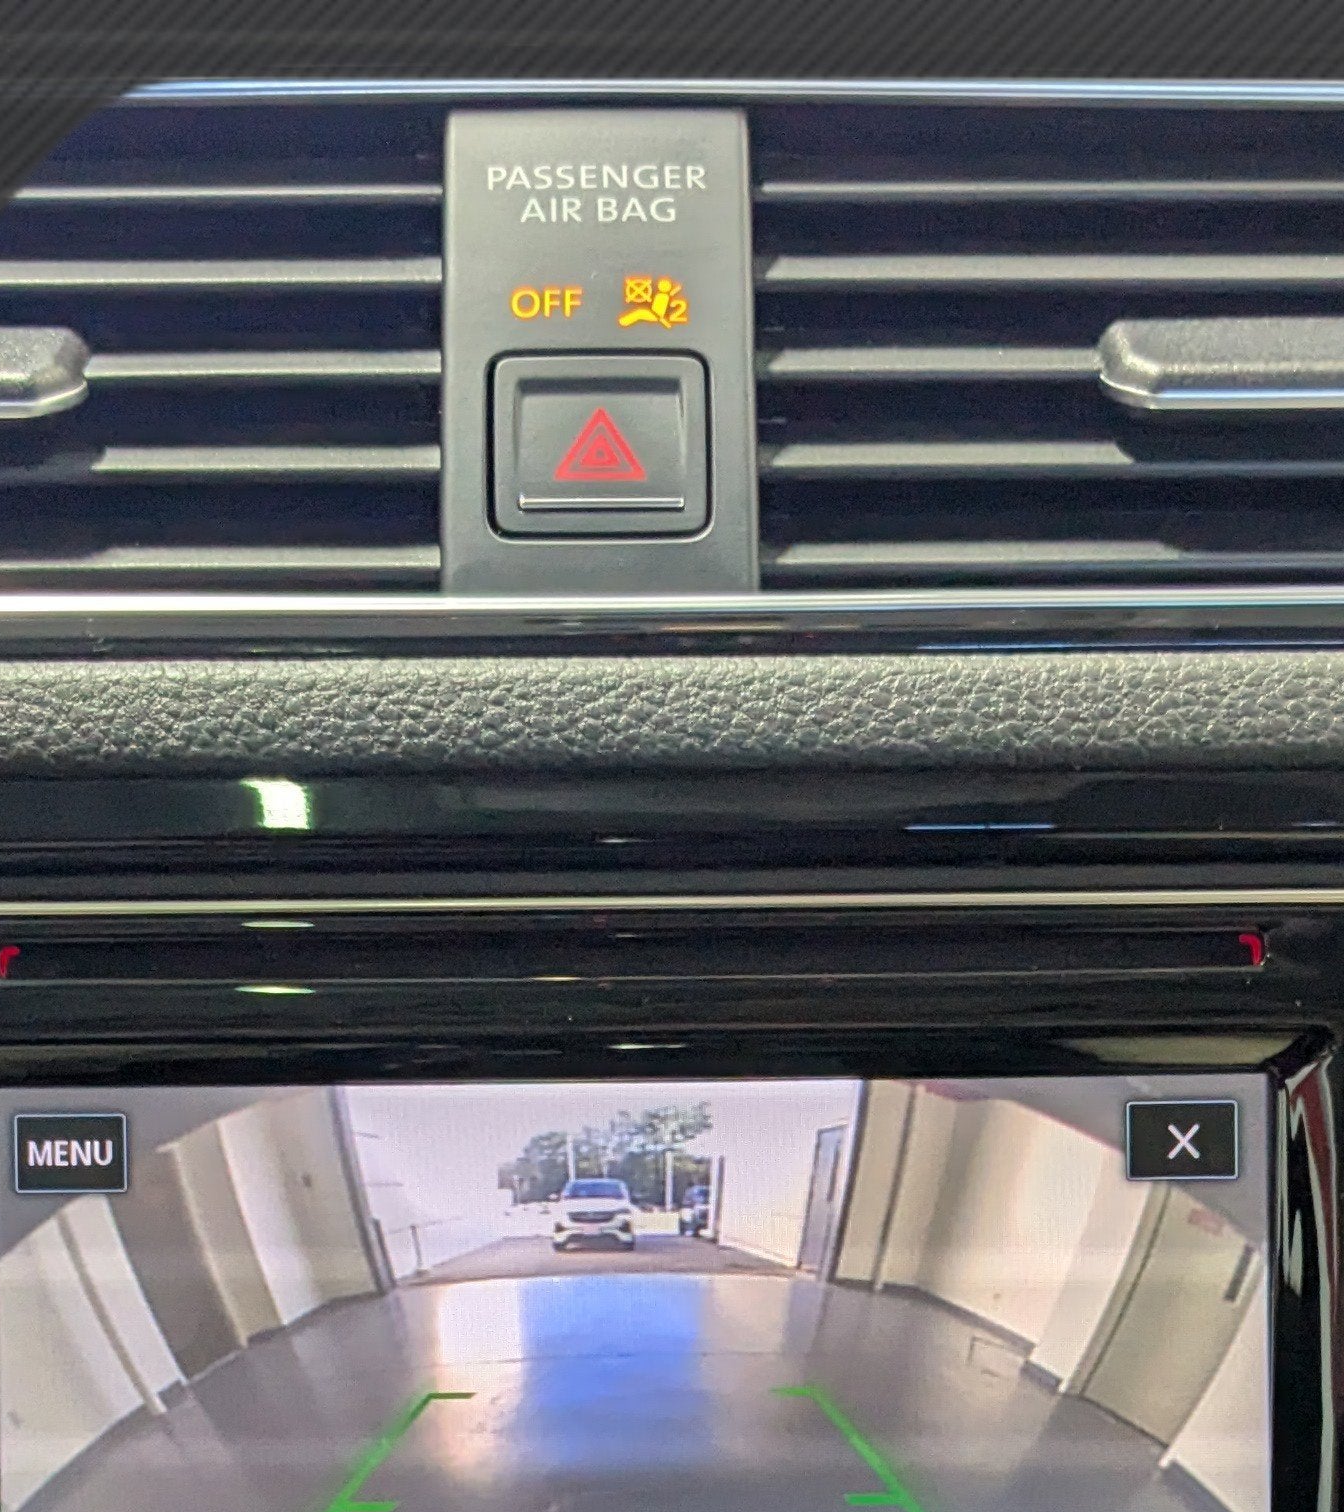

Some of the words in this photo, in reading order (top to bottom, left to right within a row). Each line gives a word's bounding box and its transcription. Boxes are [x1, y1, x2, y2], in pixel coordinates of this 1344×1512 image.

[487, 164, 707, 191] PASSENGER
[519, 197, 583, 222] AIR
[596, 197, 677, 222] BAG
[510, 286, 584, 319] OFF
[26, 1139, 114, 1167] MENU
